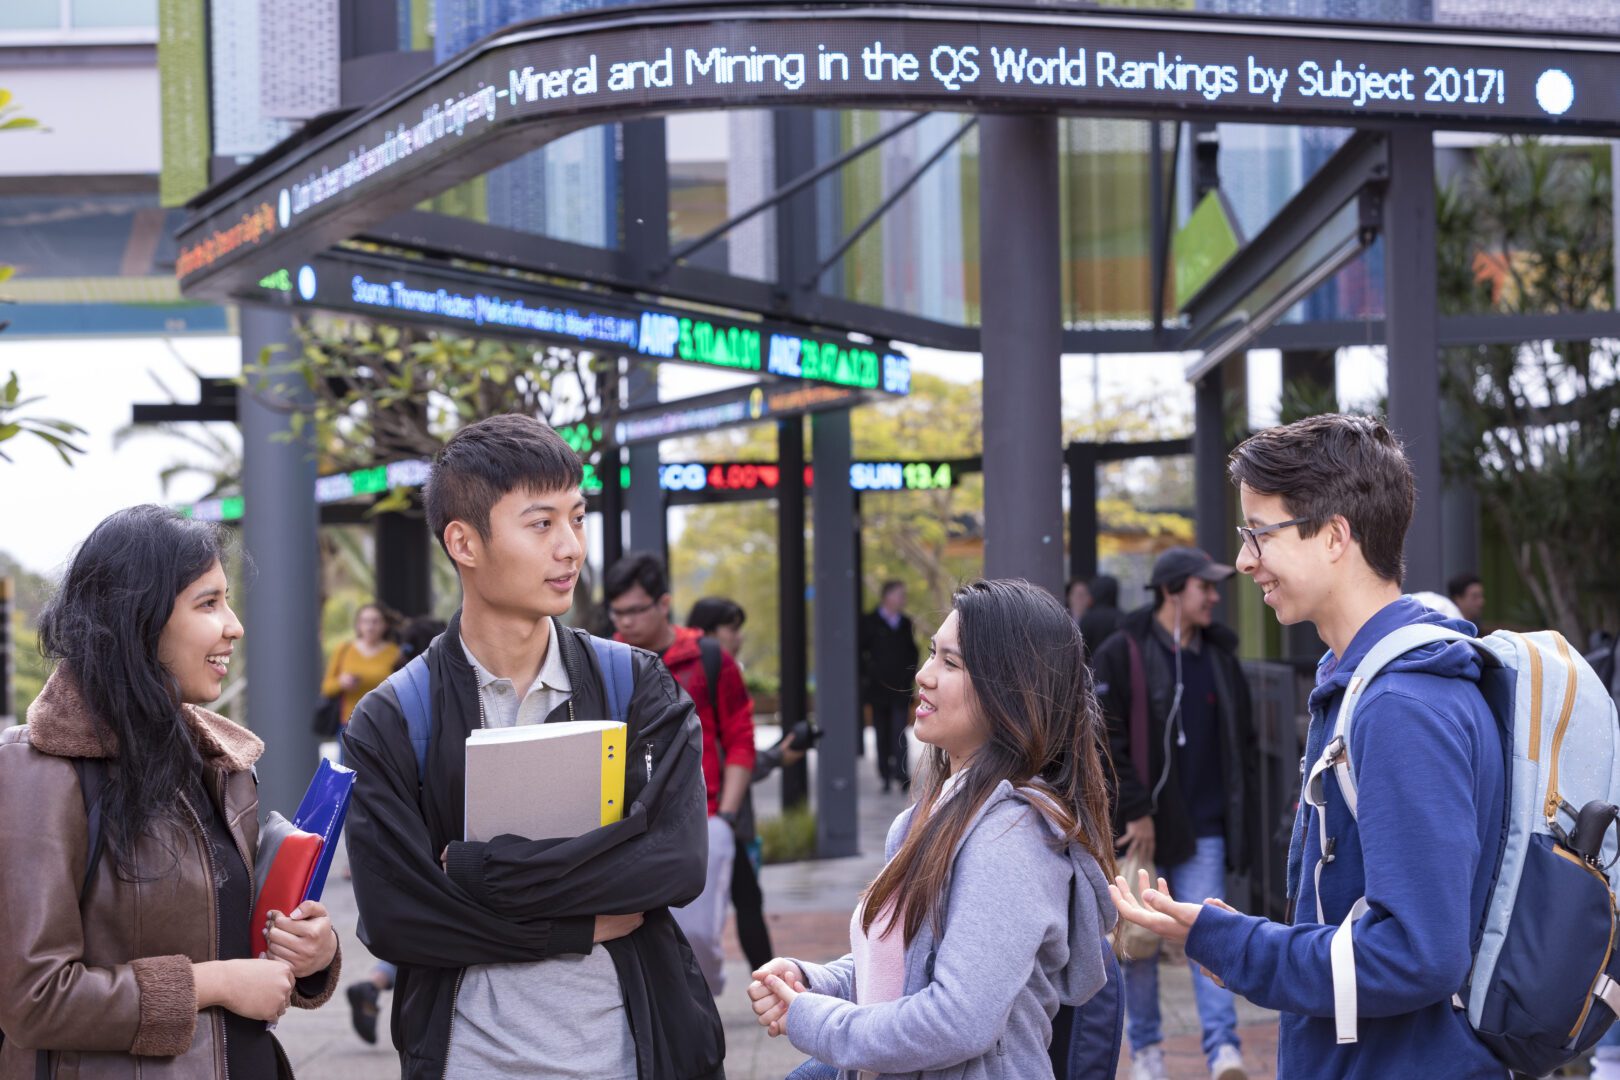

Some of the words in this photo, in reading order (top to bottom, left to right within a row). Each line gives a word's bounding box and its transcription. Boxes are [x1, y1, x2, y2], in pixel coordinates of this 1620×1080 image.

[509, 55, 598, 106] Mineral
[607, 47, 674, 92] and
[685, 46, 806, 90] Mining
[818, 45, 849, 81] in
[861, 41, 920, 81] the
[930, 45, 980, 91] QS
[990, 46, 1087, 87] World
[1096, 51, 1238, 101] Rankings
[1247, 55, 1289, 104] by
[1298, 59, 1415, 107] Subject
[1424, 66, 1505, 104] 2017!
[638, 311, 679, 358] AMP
[768, 333, 802, 377] ANZ
[850, 462, 902, 490] SUN
